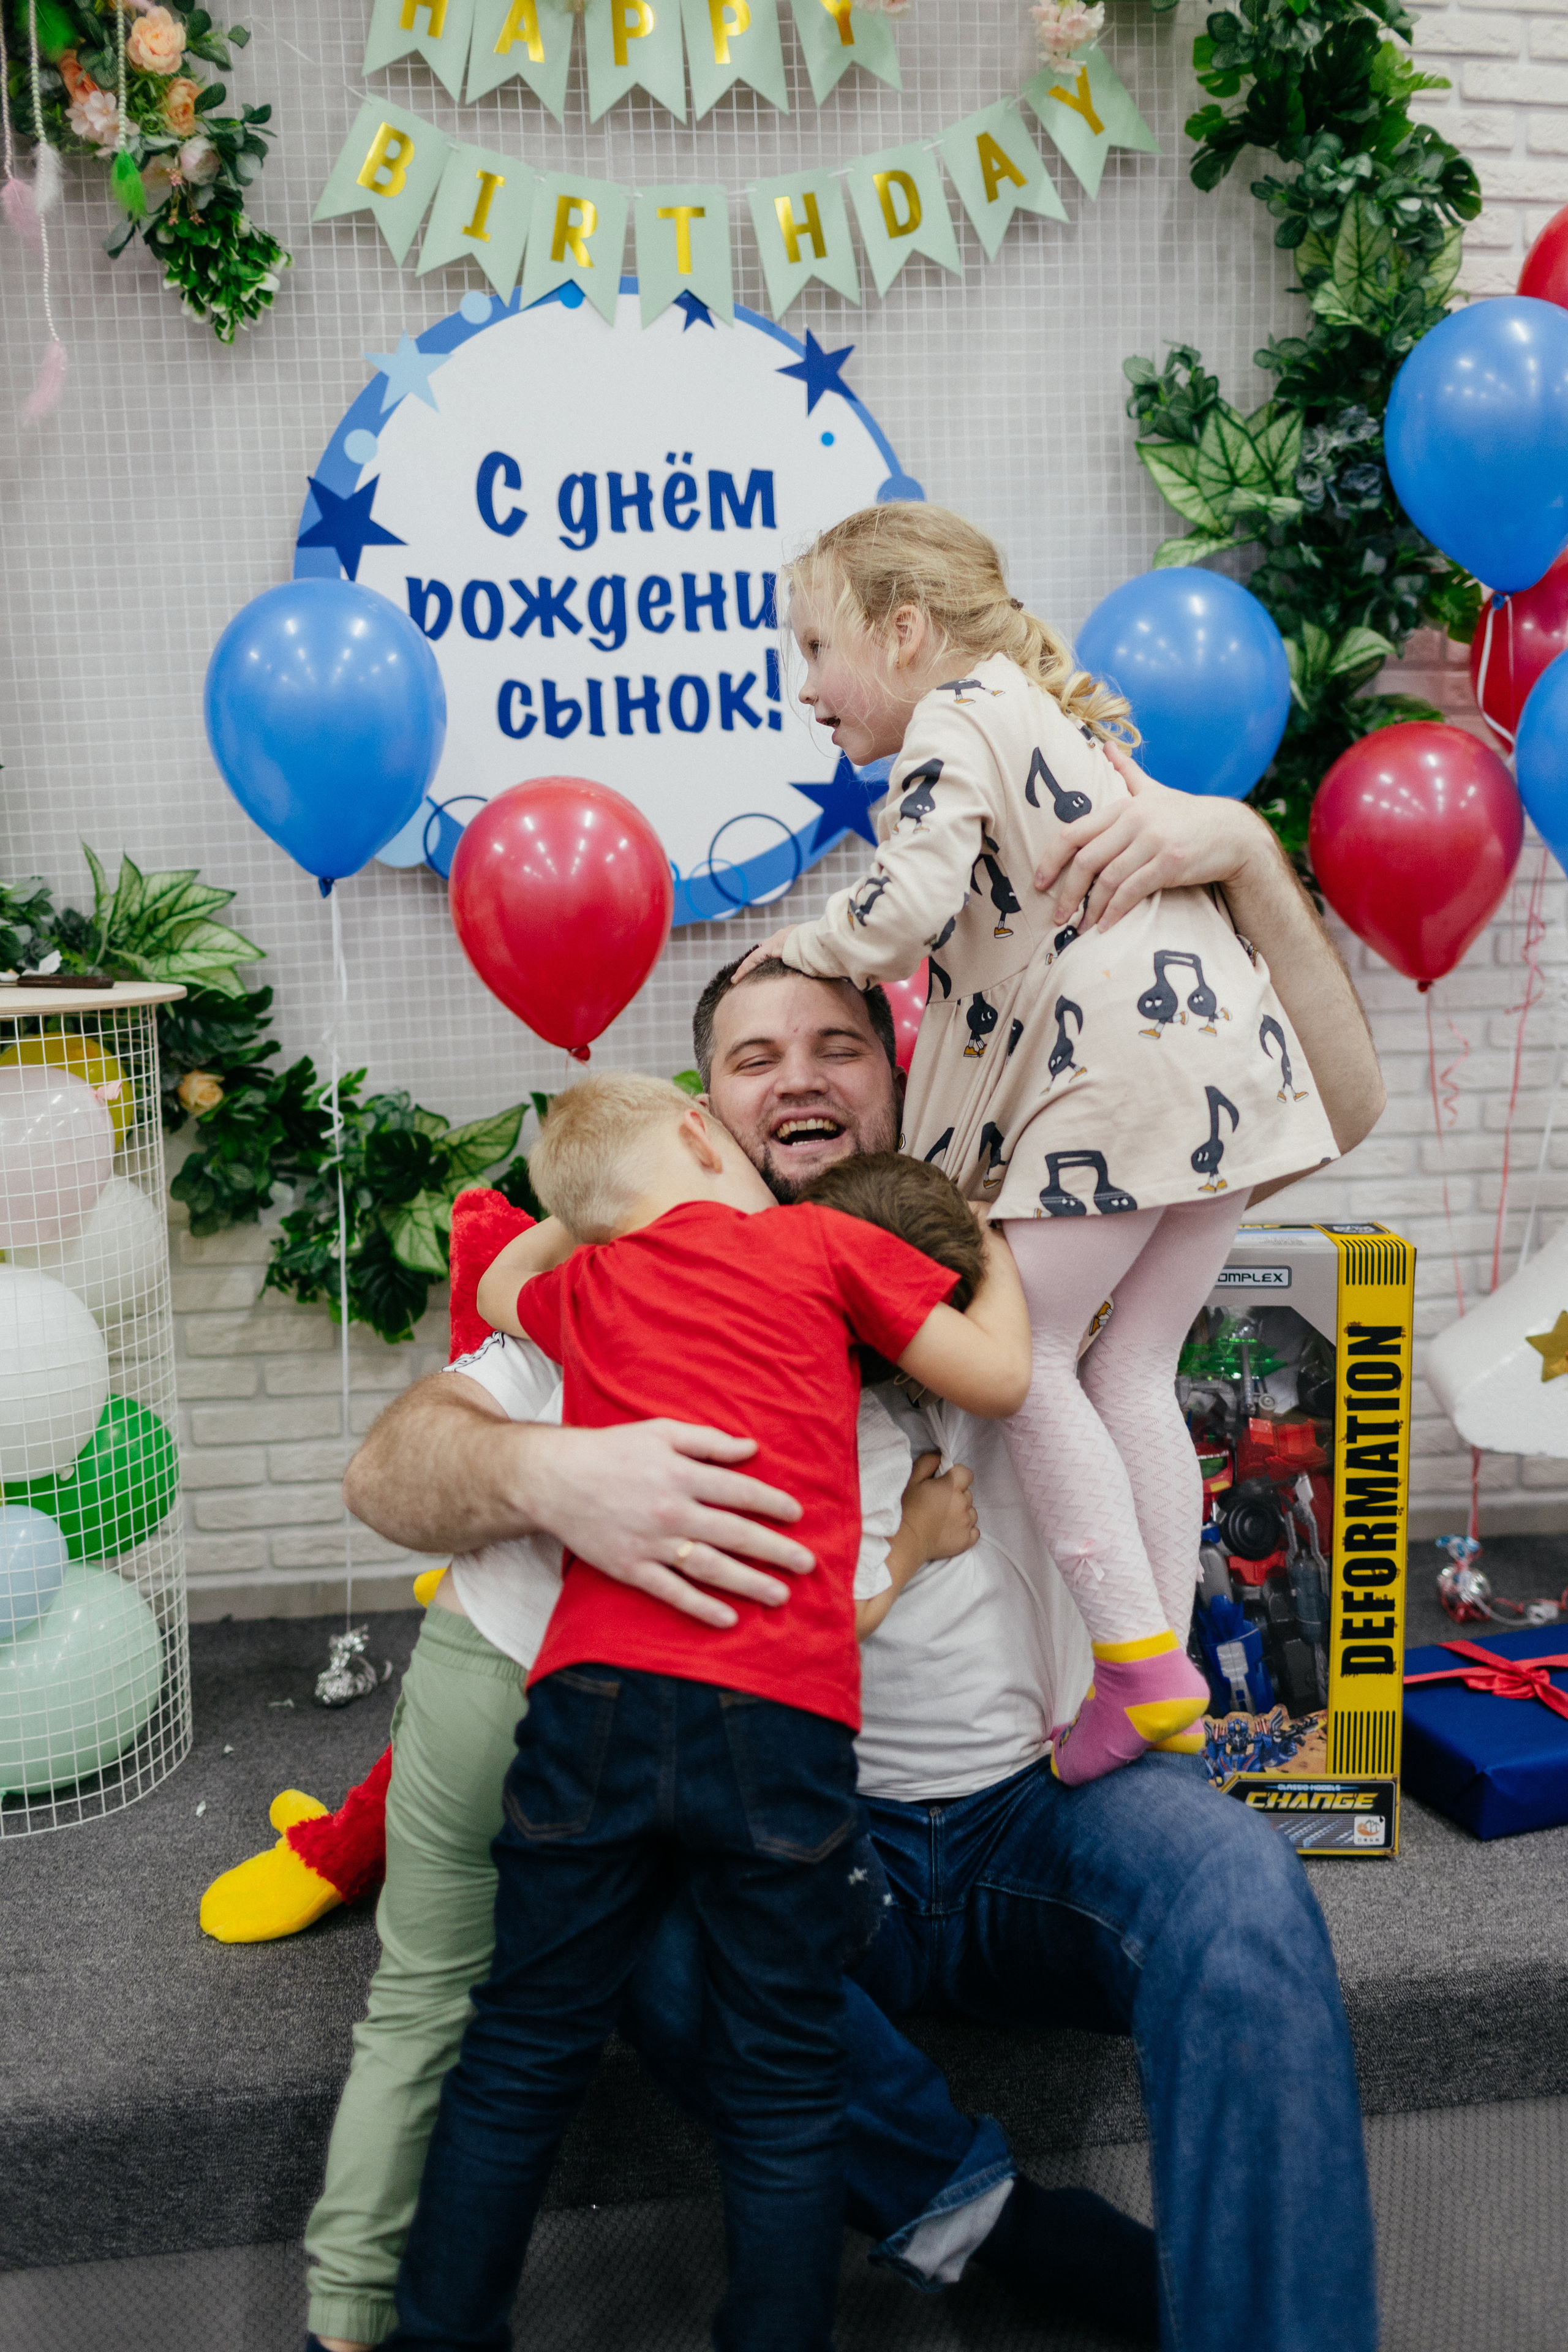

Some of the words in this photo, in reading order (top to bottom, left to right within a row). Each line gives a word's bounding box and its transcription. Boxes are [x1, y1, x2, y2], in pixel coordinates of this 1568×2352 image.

[399, 0, 855, 66] HAPPY
[356, 67, 1105, 275] BIRTHDAY
[476, 451, 527, 537] С
[557, 451, 777, 551] днём
[405, 570, 777, 652] рождени
[497, 647, 782, 739] сынок!
[1217, 1272, 1284, 1283] OMPLEX
[1340, 1325, 1402, 1675] DEFORMATION
[1245, 1791, 1379, 1810] CHANGE
